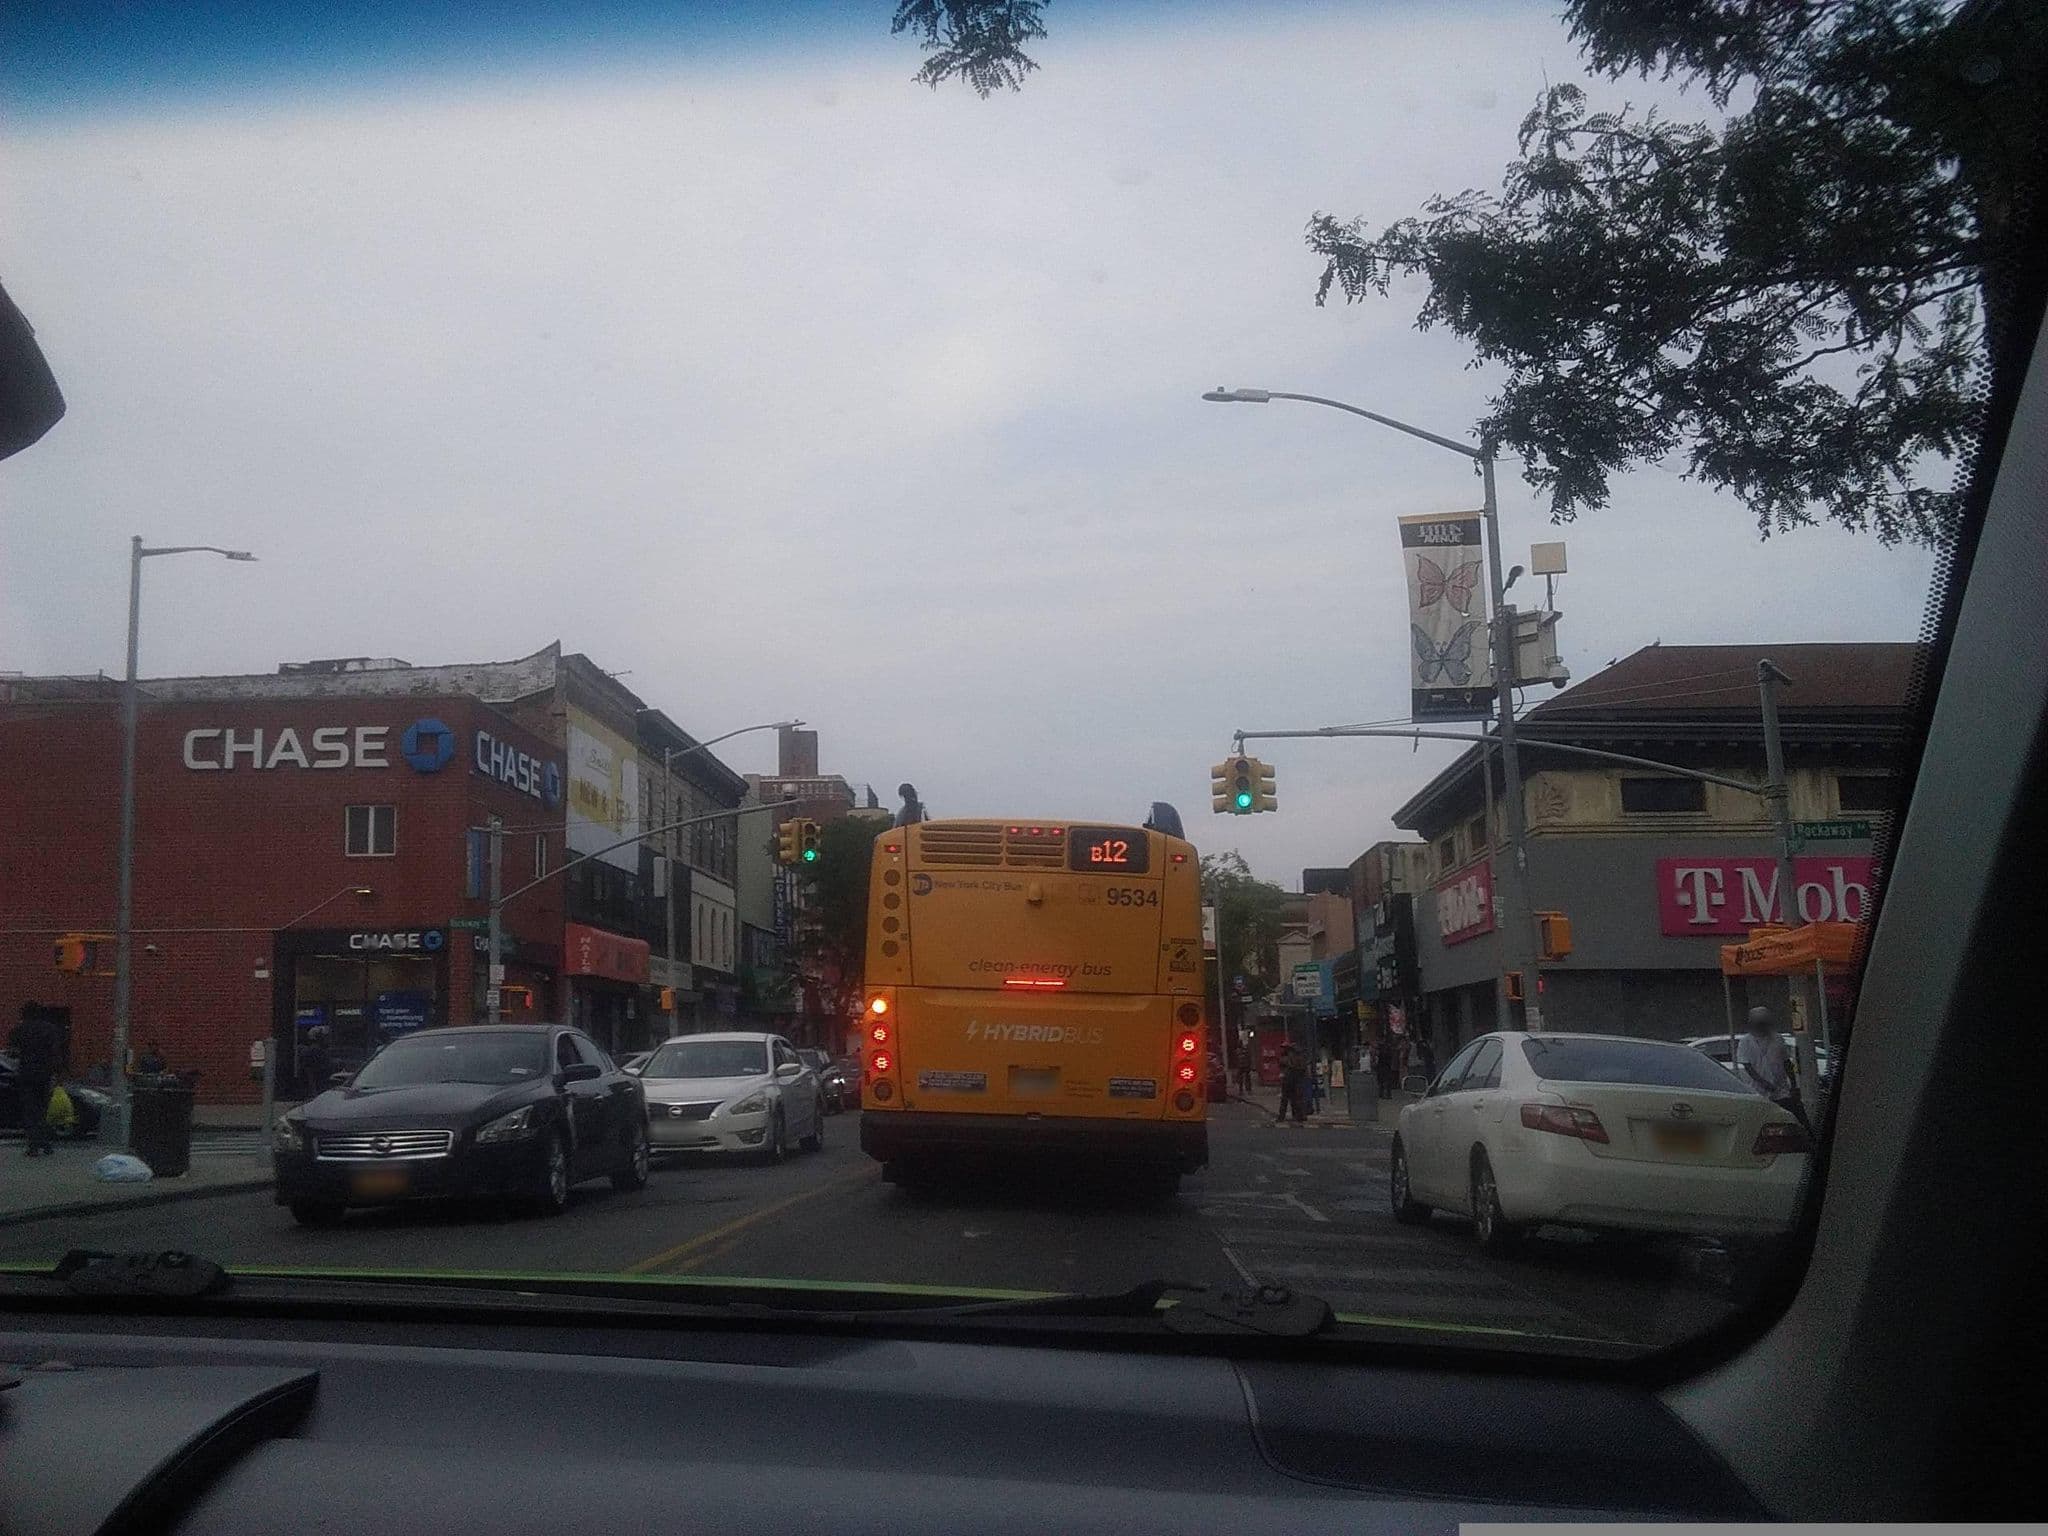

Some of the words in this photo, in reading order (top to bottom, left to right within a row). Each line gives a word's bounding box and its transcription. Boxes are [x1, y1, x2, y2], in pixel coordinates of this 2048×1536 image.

[183, 726, 389, 770] CHASE
[475, 729, 542, 799] CHASE
[1797, 823, 1853, 839] Rockaway
[1090, 840, 1128, 864] B12
[982, 880, 1003, 892] City
[1106, 887, 1159, 908] 9534
[349, 933, 421, 950] CHASE
[968, 959, 1077, 977] clean-energy
[1082, 962, 1113, 977] bus
